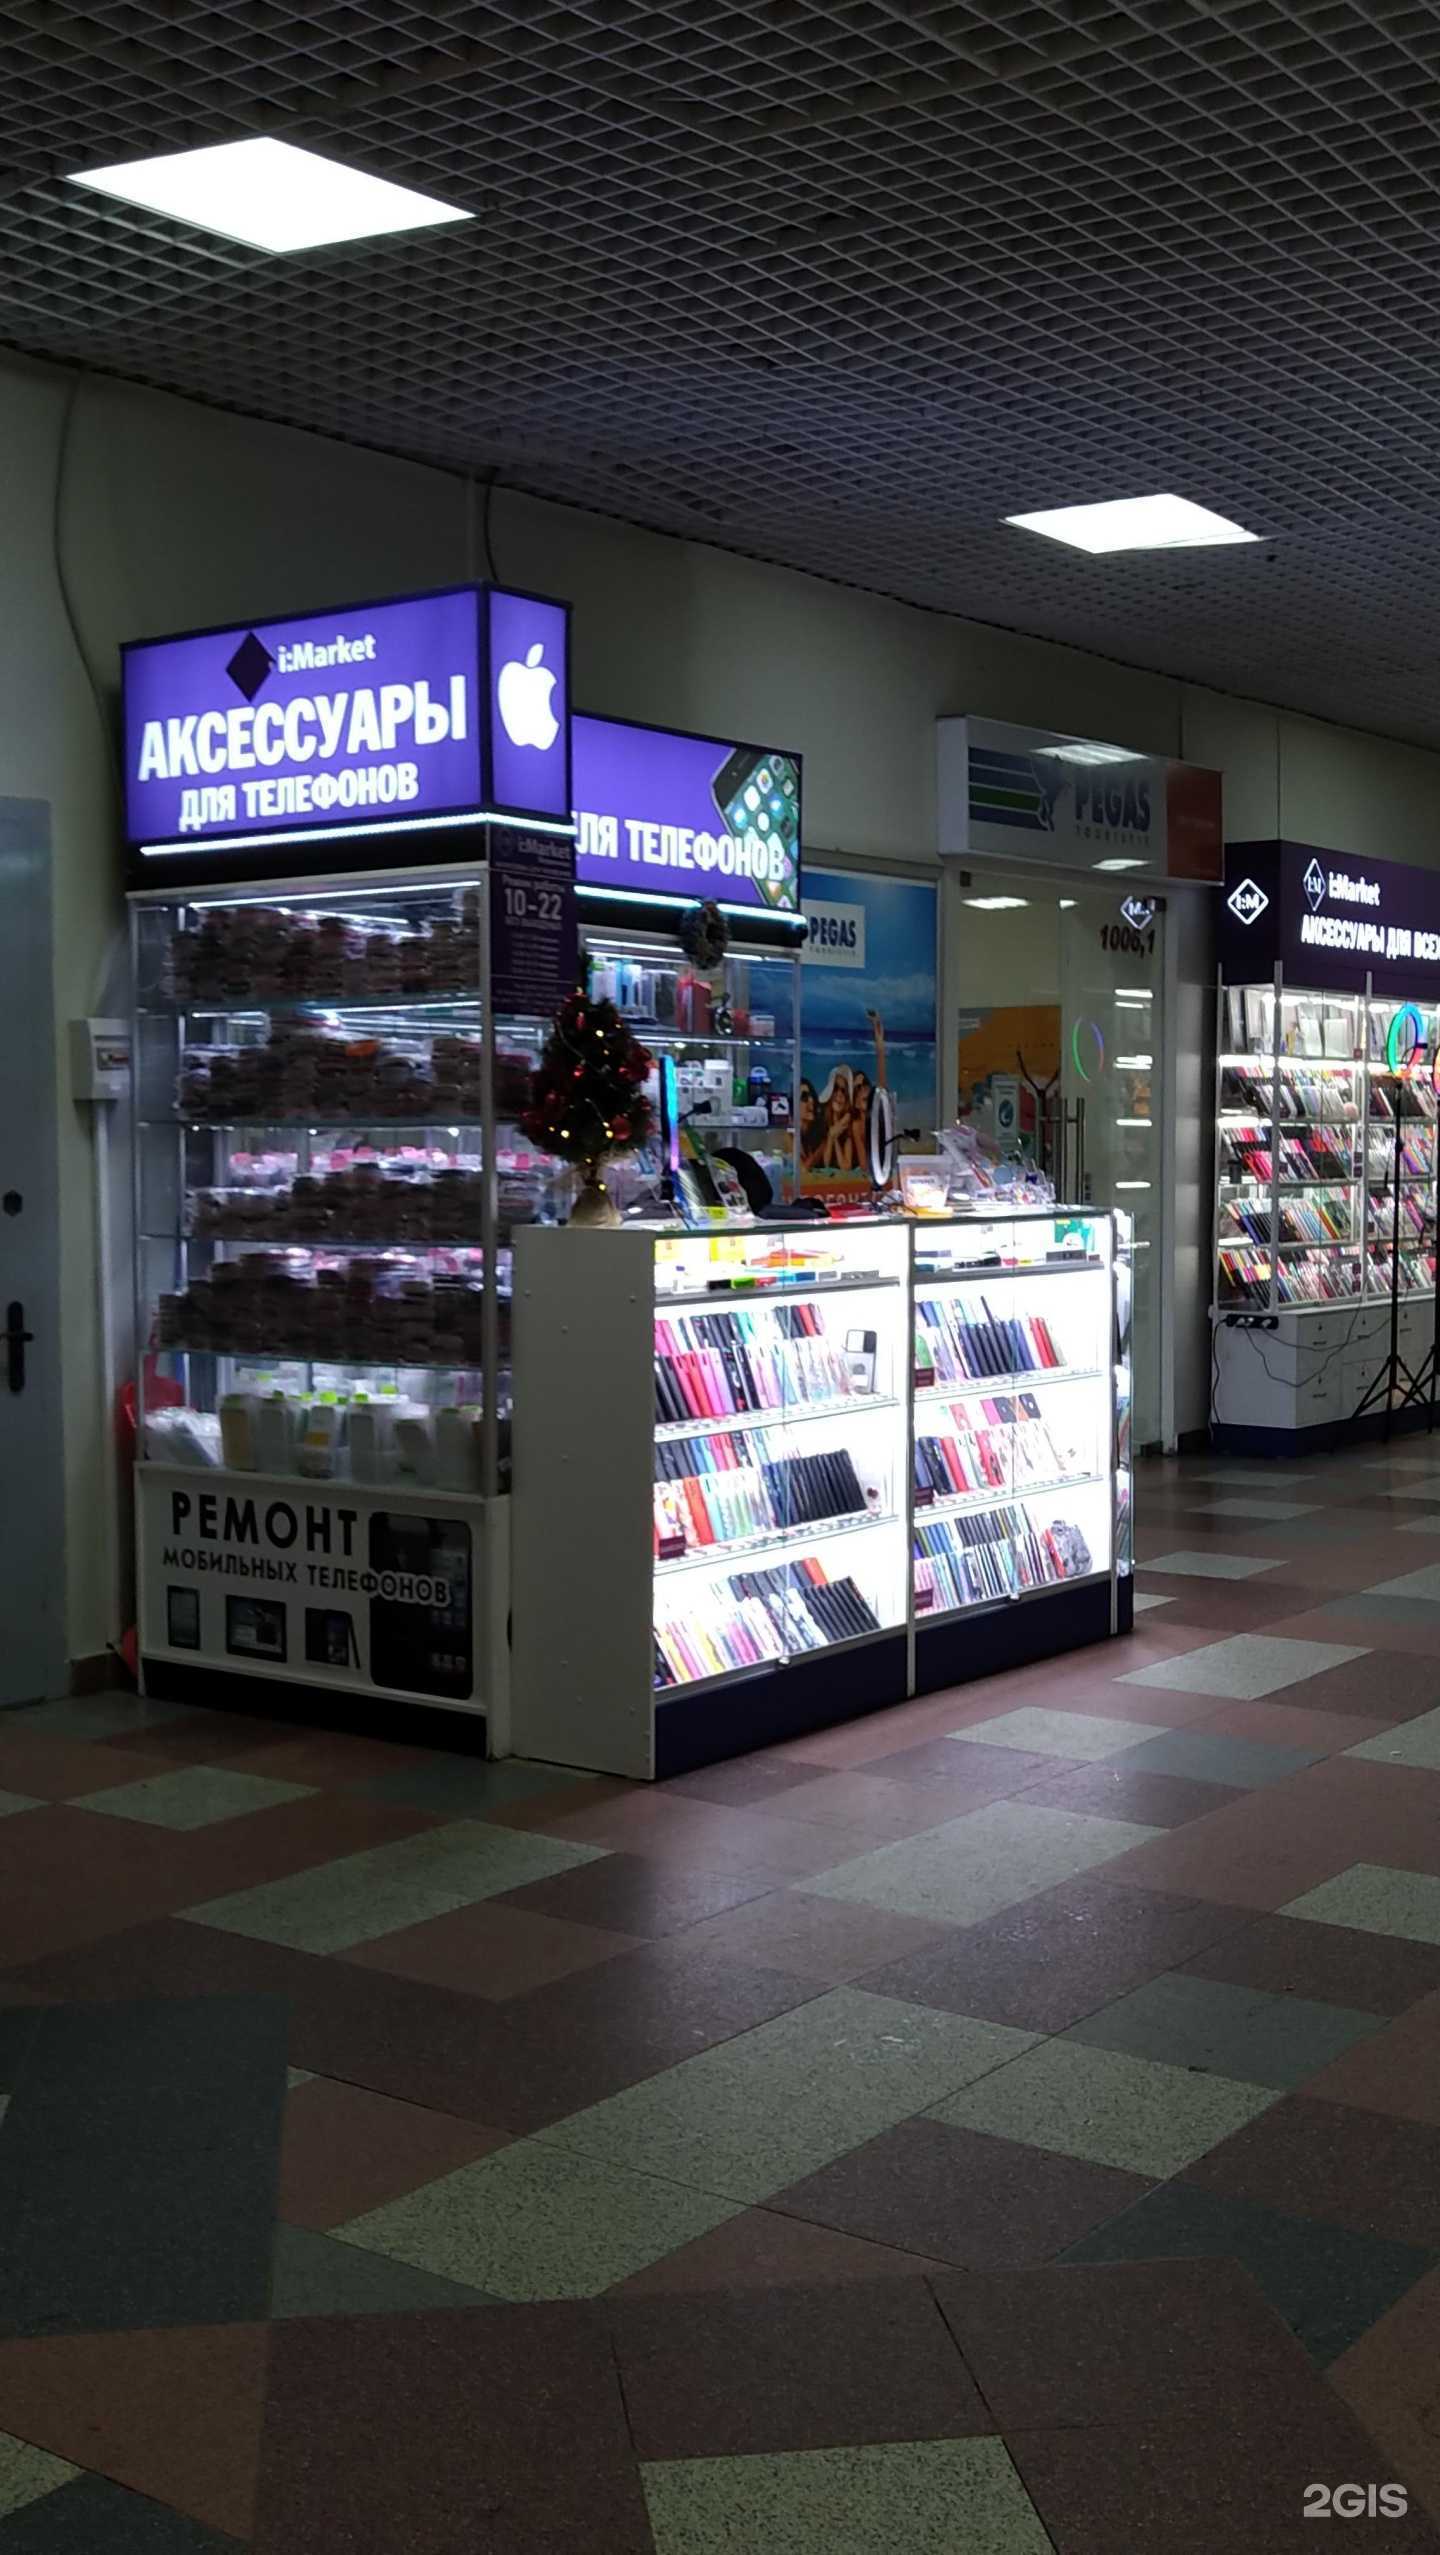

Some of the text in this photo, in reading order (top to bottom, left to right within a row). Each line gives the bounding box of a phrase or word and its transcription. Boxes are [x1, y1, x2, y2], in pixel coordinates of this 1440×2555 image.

[277, 634, 377, 673] i:Market
[137, 674, 467, 781] АКСЕССУАРЫ
[178, 762, 419, 832] ДЛЯ ТЕЛЕФОНОВ
[1074, 768, 1151, 832] PEGAS
[571, 811, 785, 882] ЛЯ ТЕЛЕФОНОВ
[504, 887, 563, 921] 10-22
[810, 916, 857, 949] PEGAS
[1301, 914, 1385, 954] АКСЕССУАРЫ
[1386, 927, 1412, 960] ДЛЯ
[171, 1490, 358, 1556] РЕМОНТ
[162, 1547, 450, 1604] МОБИЛЬНЫХ ТЕЛЕФОНОВ
